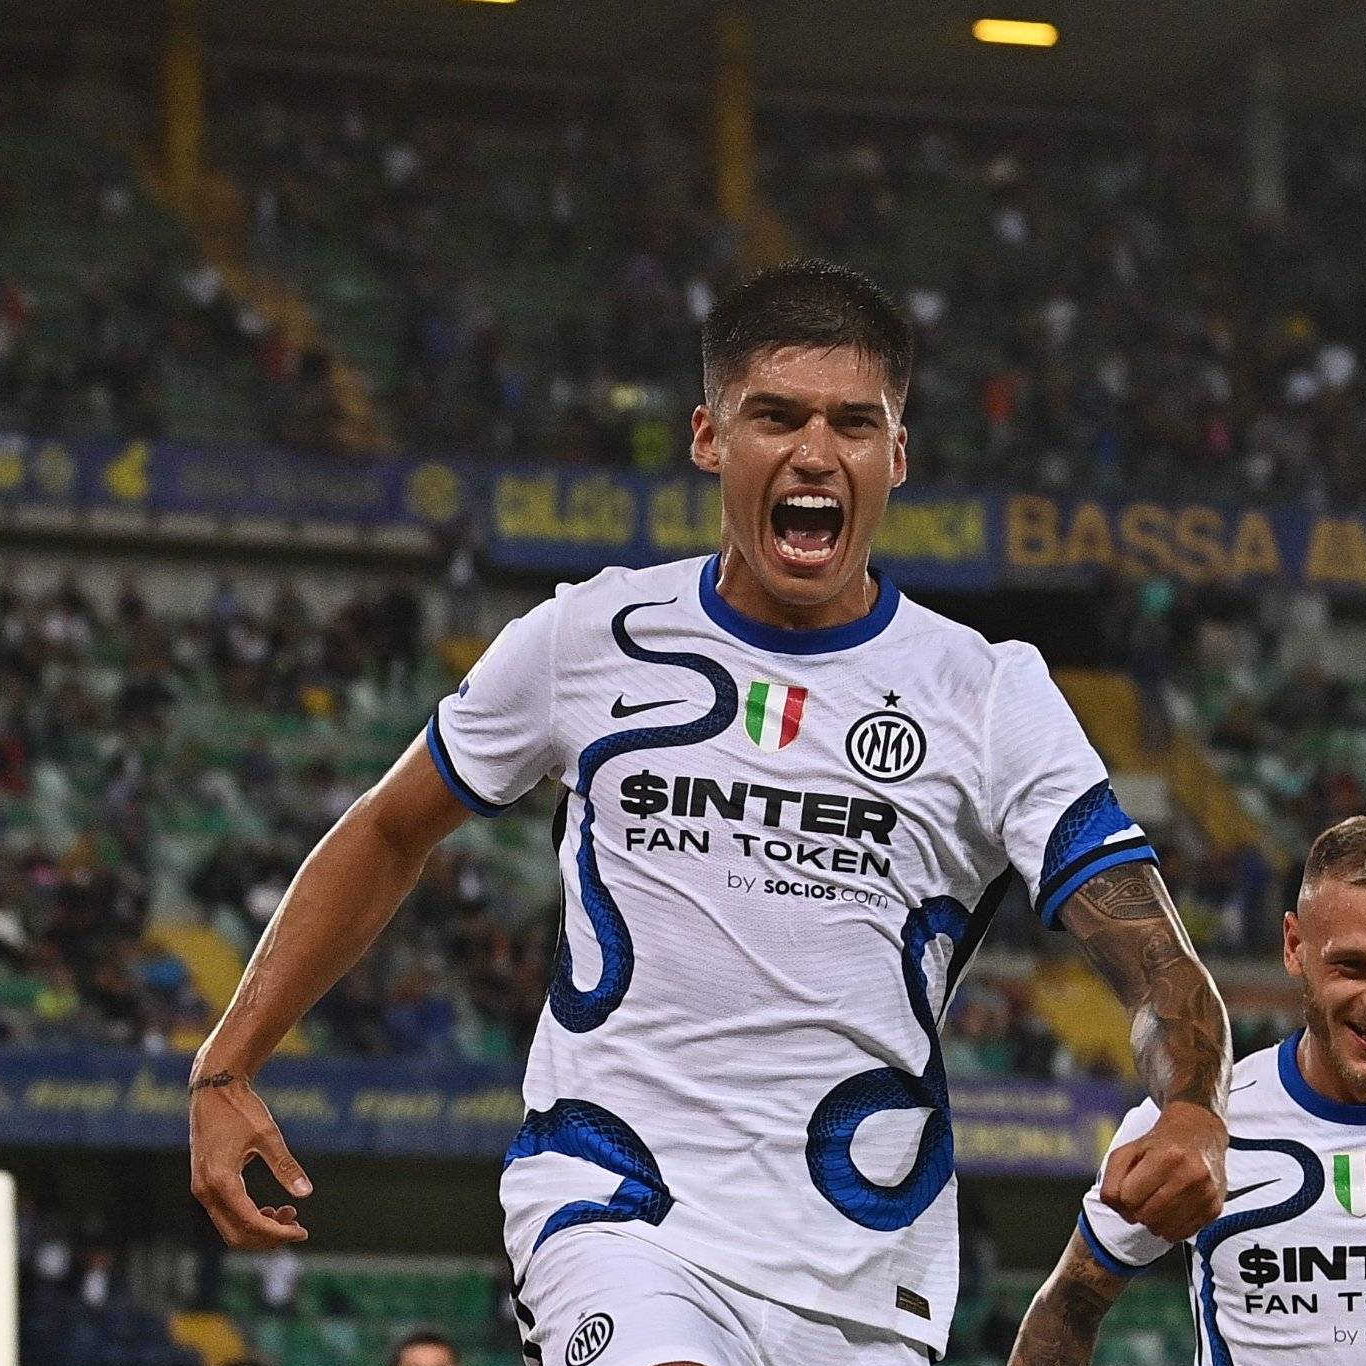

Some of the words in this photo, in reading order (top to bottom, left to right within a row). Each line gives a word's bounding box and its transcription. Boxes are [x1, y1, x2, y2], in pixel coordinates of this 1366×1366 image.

[1006, 496, 1281, 586] BASSA
[625, 828, 710, 854] FAN
[733, 834, 891, 879] TOKEN
[727, 871, 757, 895] by
[1245, 1293, 1318, 1314] FAN
[1334, 1325, 1359, 1346] by
